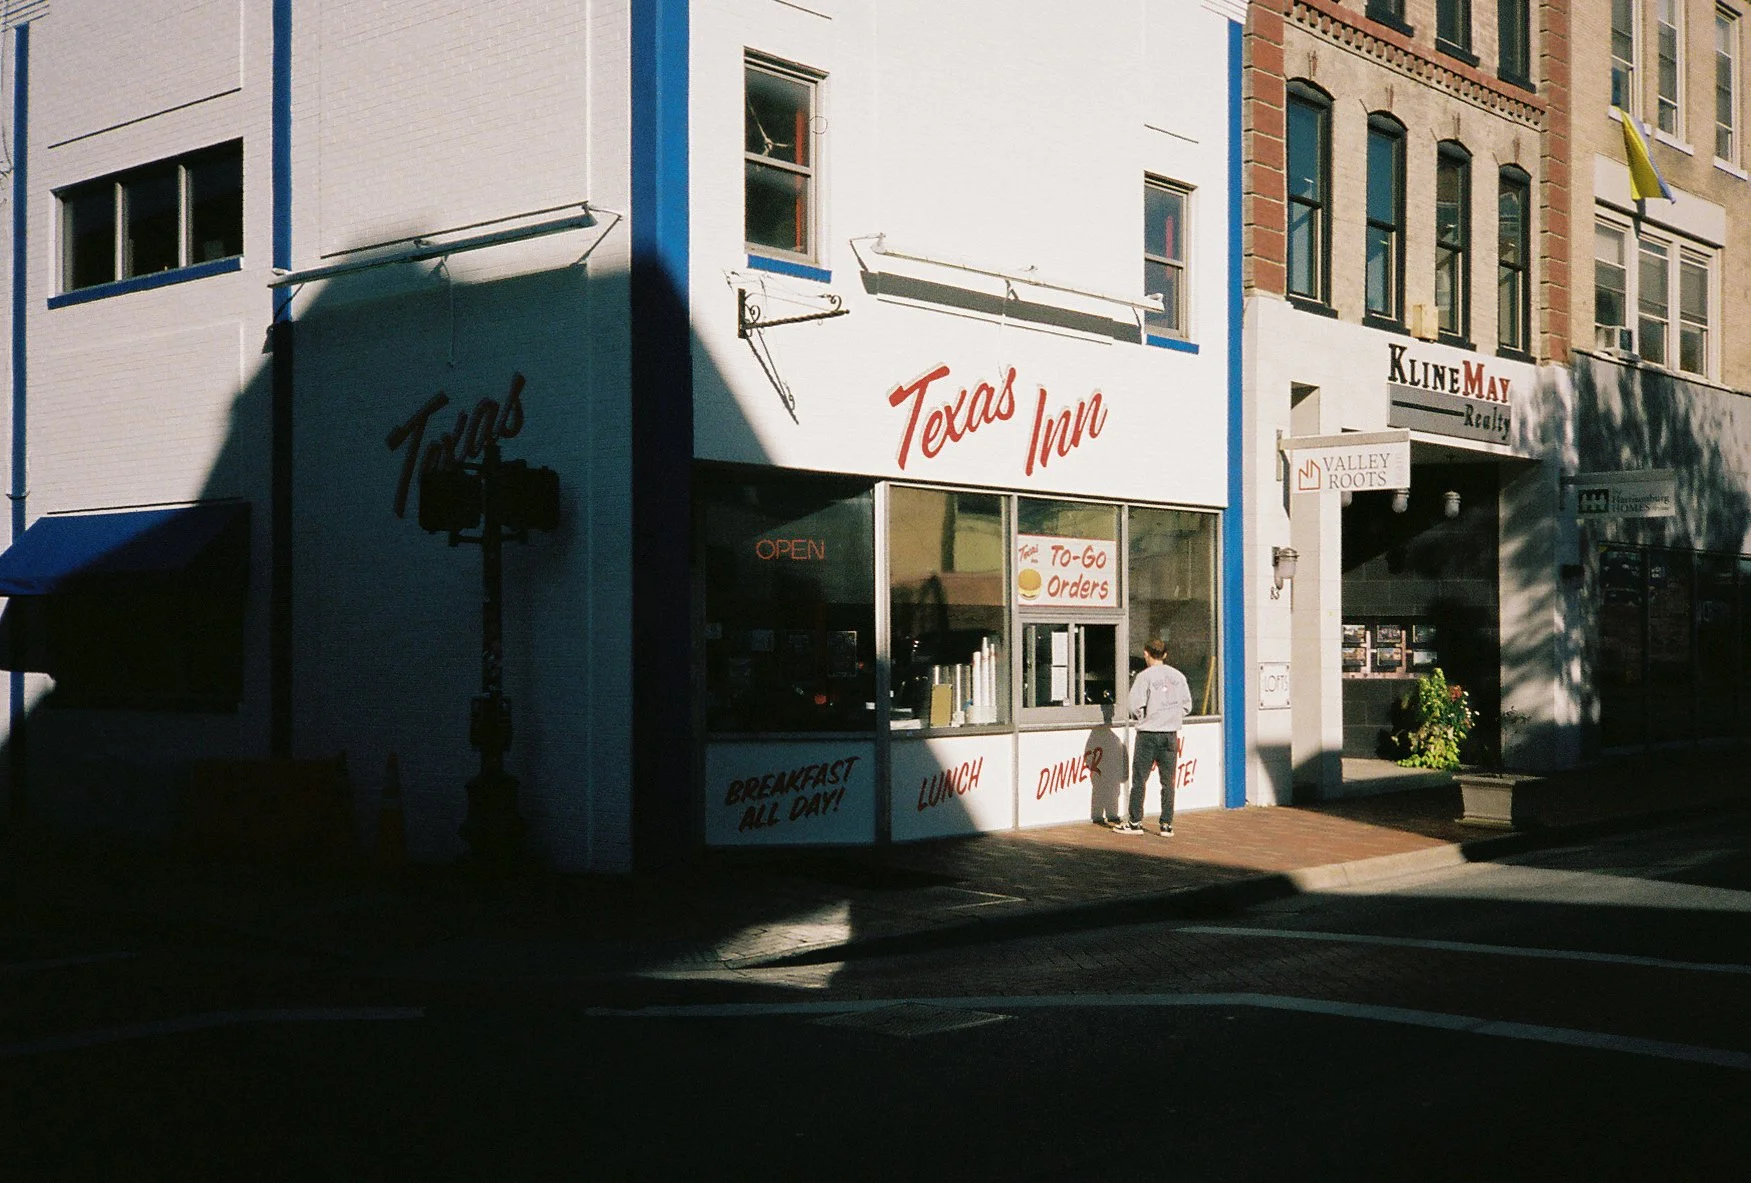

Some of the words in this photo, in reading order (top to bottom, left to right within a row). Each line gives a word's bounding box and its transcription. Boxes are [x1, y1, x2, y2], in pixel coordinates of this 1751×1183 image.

[888, 364, 1017, 471] Texas
[1024, 386, 1109, 478] Inn
[1463, 403, 1511, 440] Realty
[1323, 453, 1391, 472] VALLEY
[1329, 471, 1387, 490] ROOTS
[755, 537, 826, 560] OPEN
[1047, 572, 1109, 599] Orders
[725, 756, 861, 805] BREAKFAST
[917, 757, 984, 812] LUNCH
[1036, 746, 1104, 800] DINNER
[738, 802, 780, 833] ALL
[789, 788, 846, 822] DAY!
